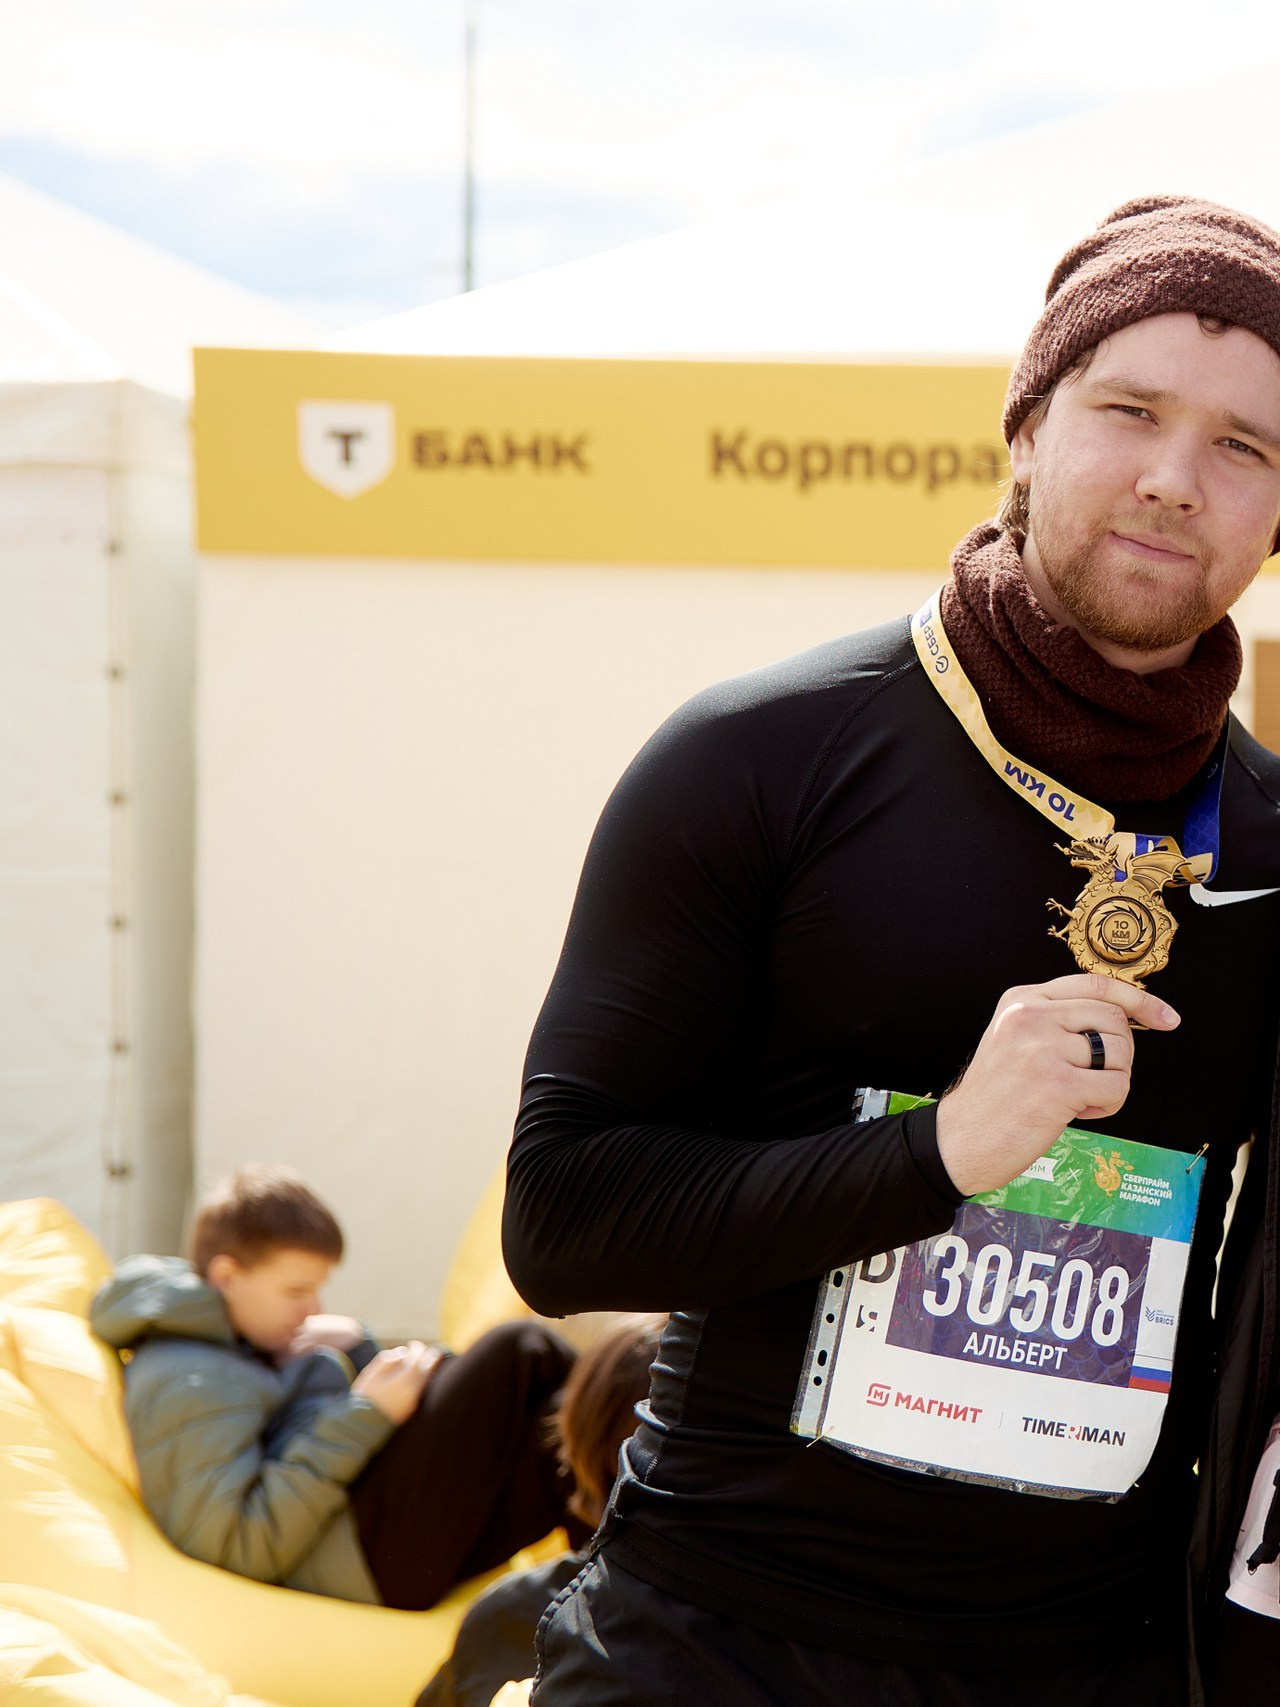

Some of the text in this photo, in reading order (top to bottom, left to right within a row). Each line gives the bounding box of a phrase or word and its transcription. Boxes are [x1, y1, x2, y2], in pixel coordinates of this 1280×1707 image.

[410, 430, 592, 473] БАНК
[709, 428, 1001, 490] Корпора
[1048, 792, 1075, 821] 10
[1114, 921, 1129, 929] 10
[1121, 1182, 1172, 1199] КАЗАНСКИЙ
[1123, 1173, 1170, 1190] СБЕРПРАЙМ
[1119, 1191, 1161, 1206] МАРАФОН
[922, 1235, 1130, 1347] 30508
[1155, 1316, 1174, 1326] BRICS
[963, 1331, 1068, 1370] АЛЬБЕРТ
[894, 1391, 983, 1424] МАГНИТ
